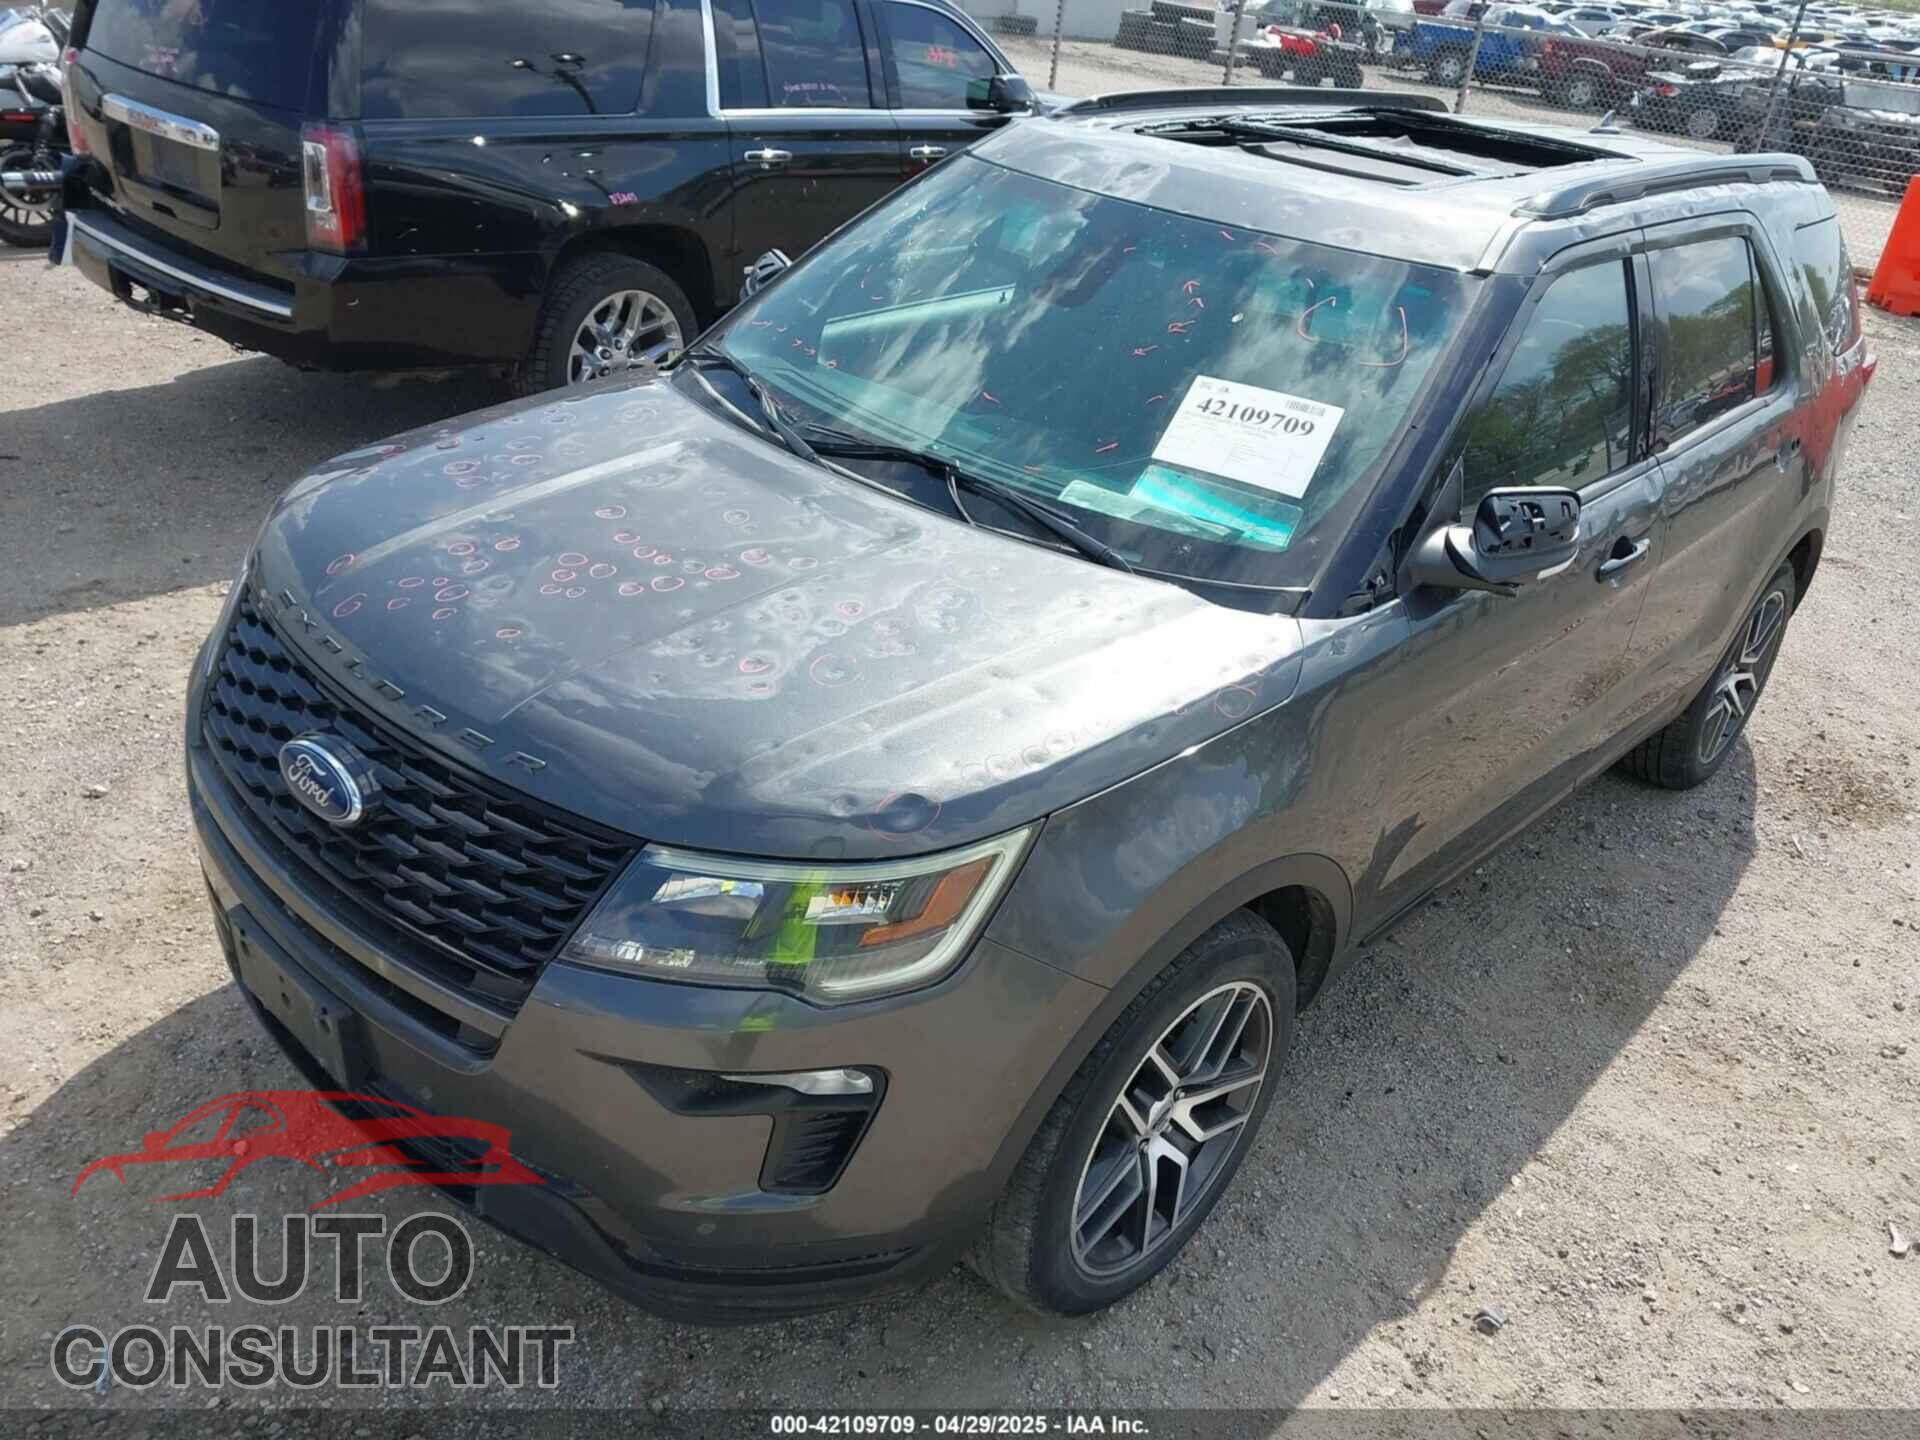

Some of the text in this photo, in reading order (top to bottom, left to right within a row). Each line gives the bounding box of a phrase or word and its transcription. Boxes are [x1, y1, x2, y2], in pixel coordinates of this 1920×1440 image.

[1196, 397, 1315, 436] 42109709
[278, 587, 548, 774] EXPLORER
[286, 753, 334, 809] Ford
